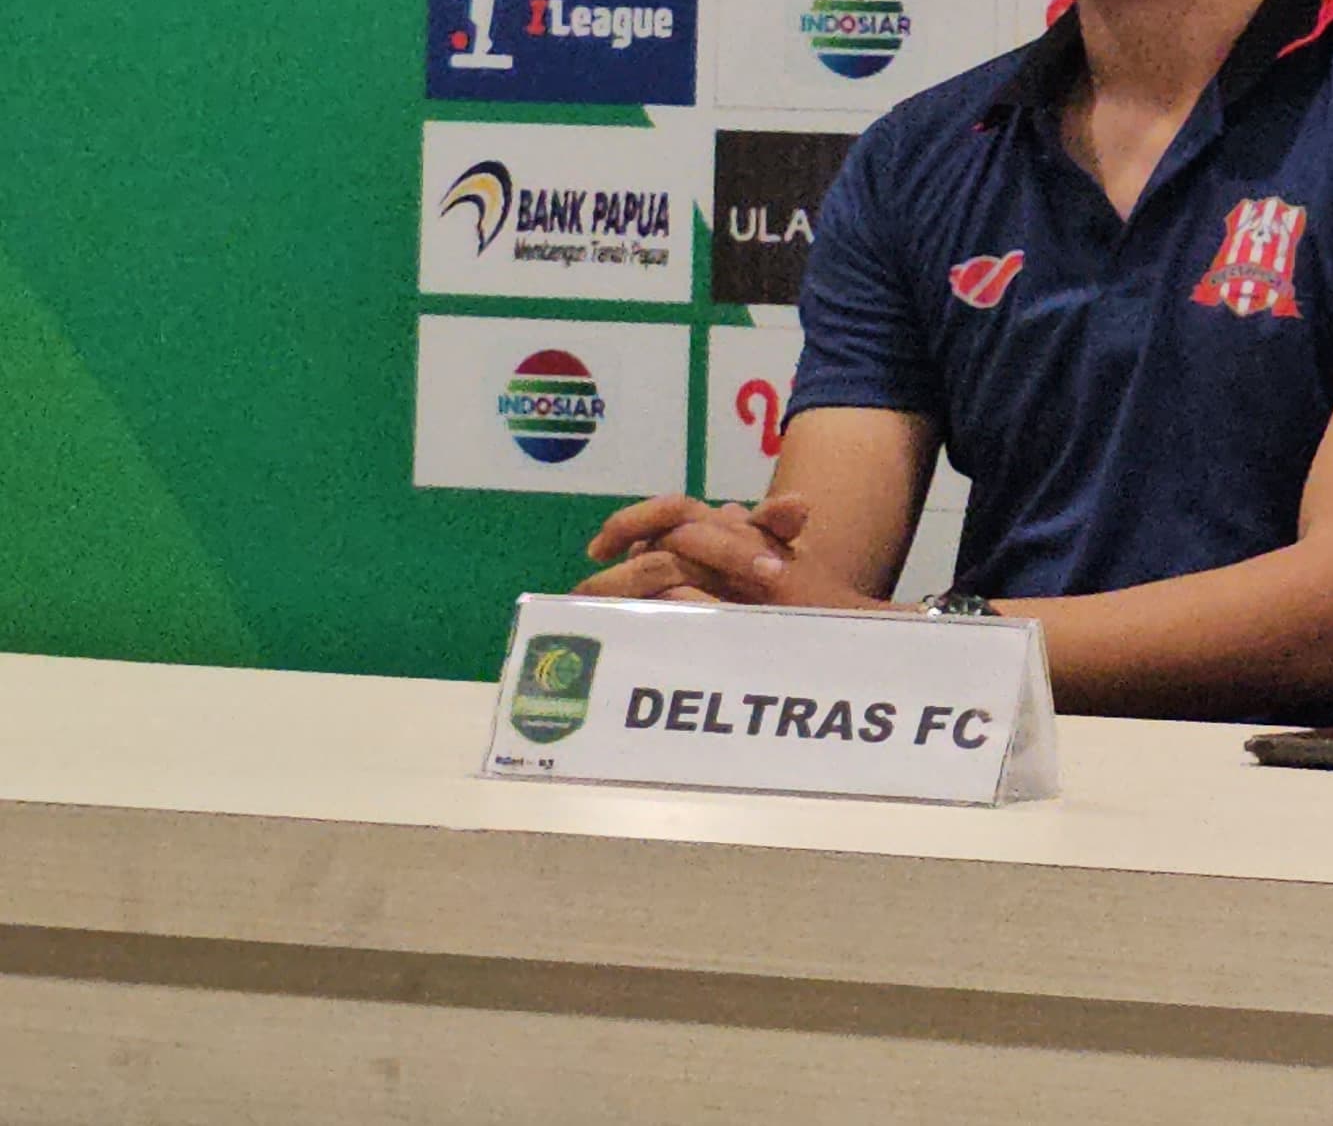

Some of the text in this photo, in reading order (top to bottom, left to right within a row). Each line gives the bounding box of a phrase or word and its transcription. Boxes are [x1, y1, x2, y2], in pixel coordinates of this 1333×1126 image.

[801, 14, 909, 37] INDOSIAR
[517, 191, 670, 237] BANK PAPUA
[730, 209, 815, 244] ULA
[499, 394, 604, 419] INDOSIAR
[625, 688, 992, 750] DELTRAS FC
